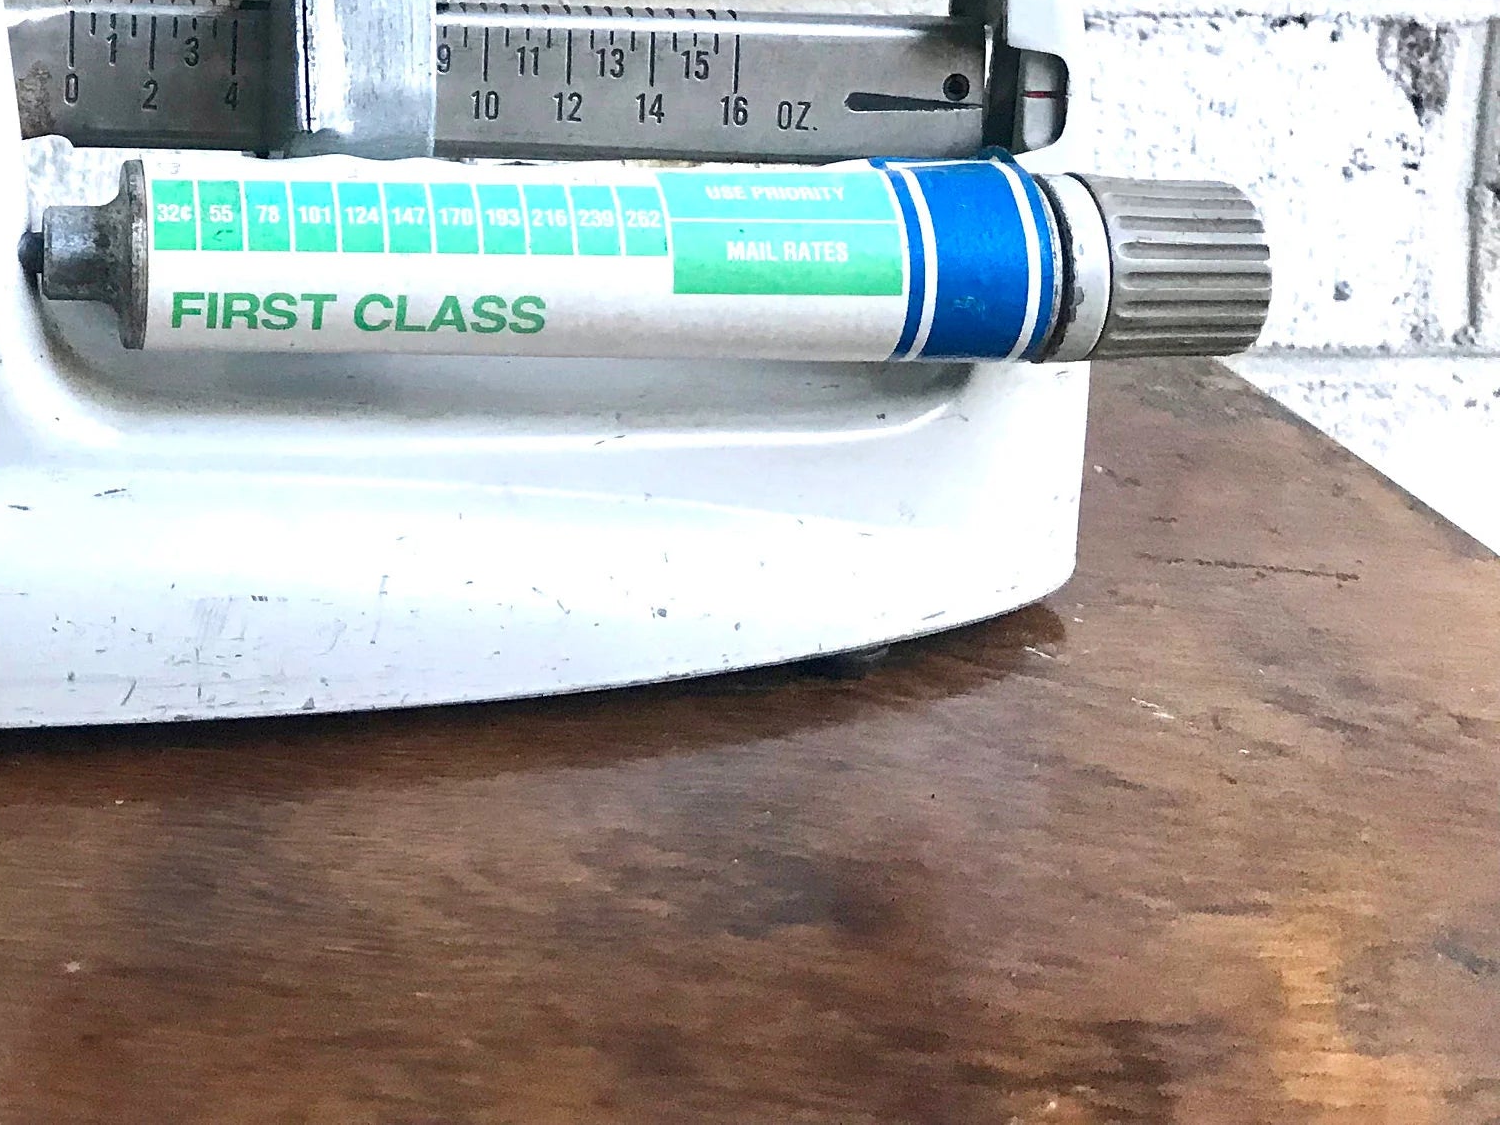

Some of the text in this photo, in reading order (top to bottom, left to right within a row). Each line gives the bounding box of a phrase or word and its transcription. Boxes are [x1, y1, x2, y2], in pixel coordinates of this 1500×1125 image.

[107, 33, 710, 80] 1 3 9 11 13 15
[65, 74, 78, 103] 0
[143, 80, 158, 109] 2
[224, 82, 238, 108] 4
[472, 90, 498, 120] 10
[553, 92, 582, 122] 12
[635, 92, 665, 124] 14
[721, 95, 748, 126] 16
[705, 186, 845, 201] USE PRIORITY
[209, 205, 233, 223] 55
[256, 205, 280, 224] 78
[298, 206, 331, 225] 101
[345, 206, 379, 226] 124
[392, 208, 425, 226] 147
[439, 208, 473, 227] 170
[485, 208, 521, 227] 193
[531, 209, 567, 227] 216
[578, 210, 614, 228] 239
[626, 211, 661, 228] 262
[727, 241, 848, 263] MAIL RATES
[172, 292, 547, 334] FIRST CLASS
